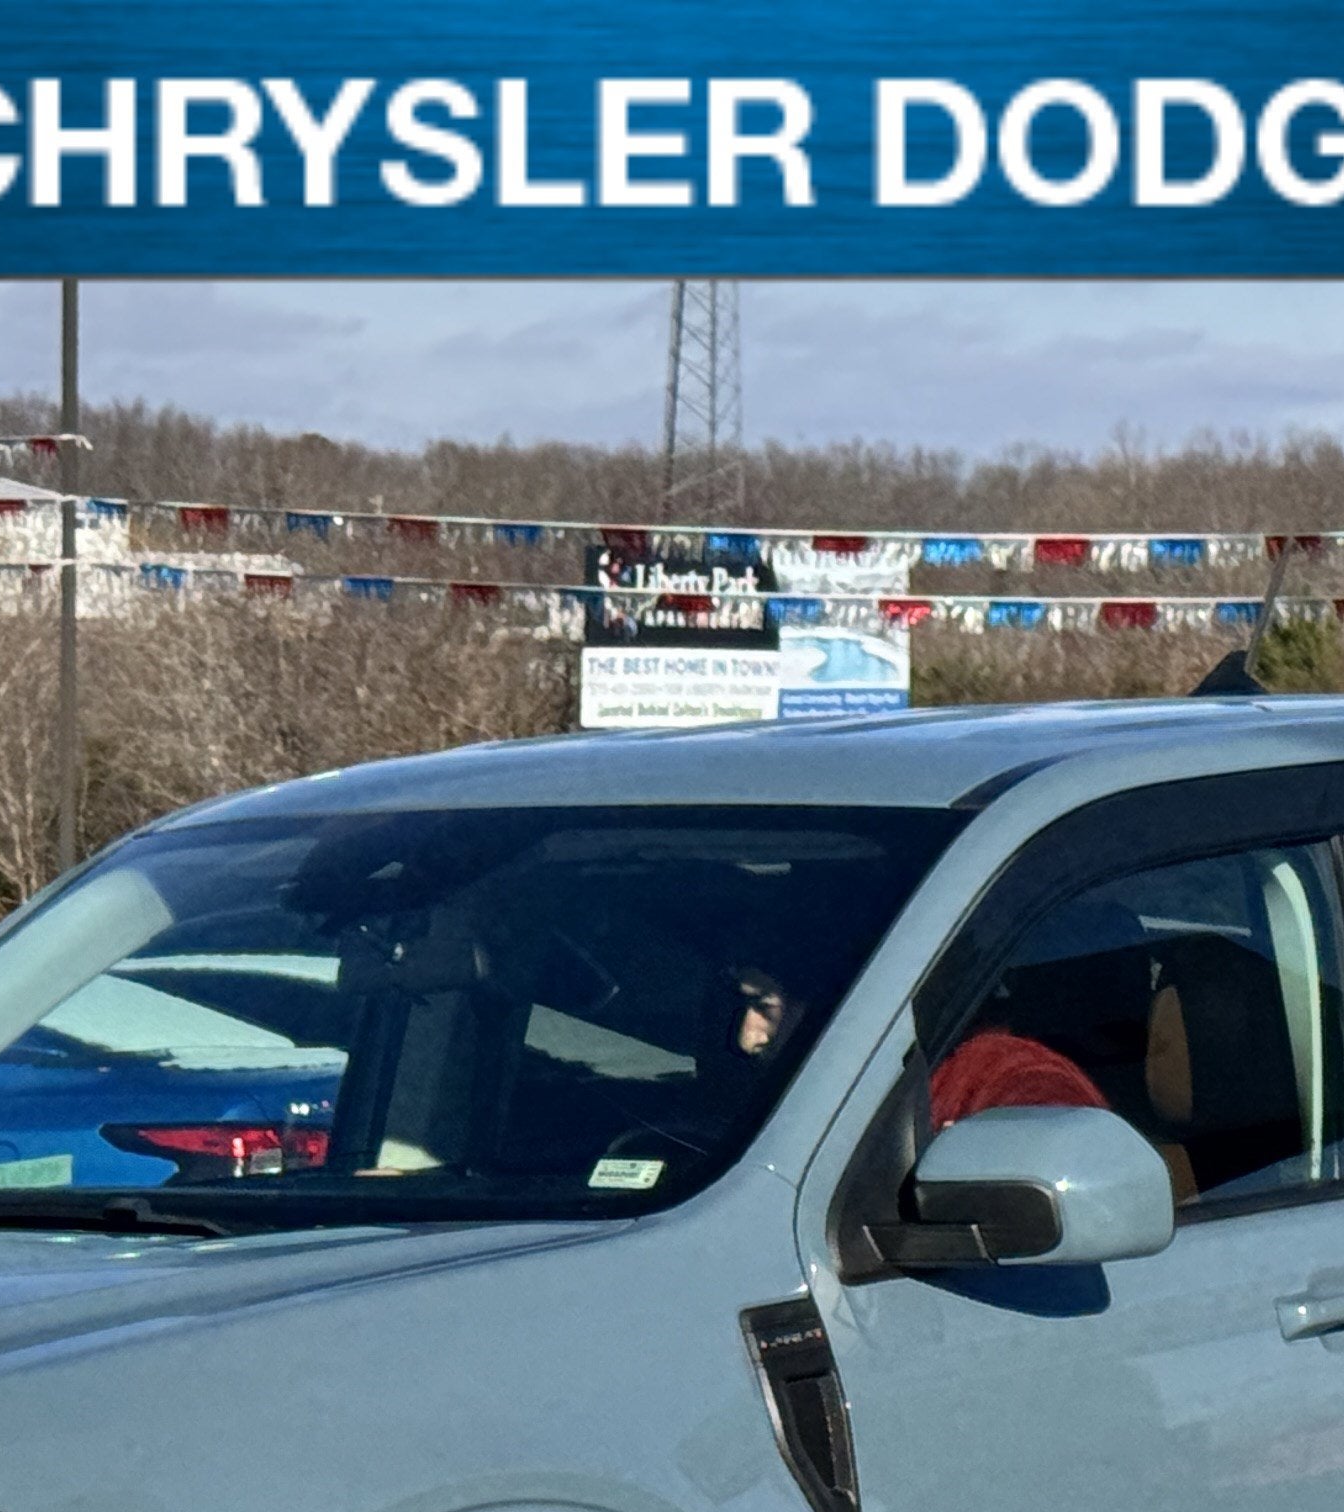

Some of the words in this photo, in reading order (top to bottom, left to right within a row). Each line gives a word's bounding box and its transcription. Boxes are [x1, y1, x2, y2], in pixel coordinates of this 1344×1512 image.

[587, 656, 618, 676] THE
[622, 656, 660, 676] BEST
[664, 656, 708, 677] HOME
[711, 657, 728, 676] IN
